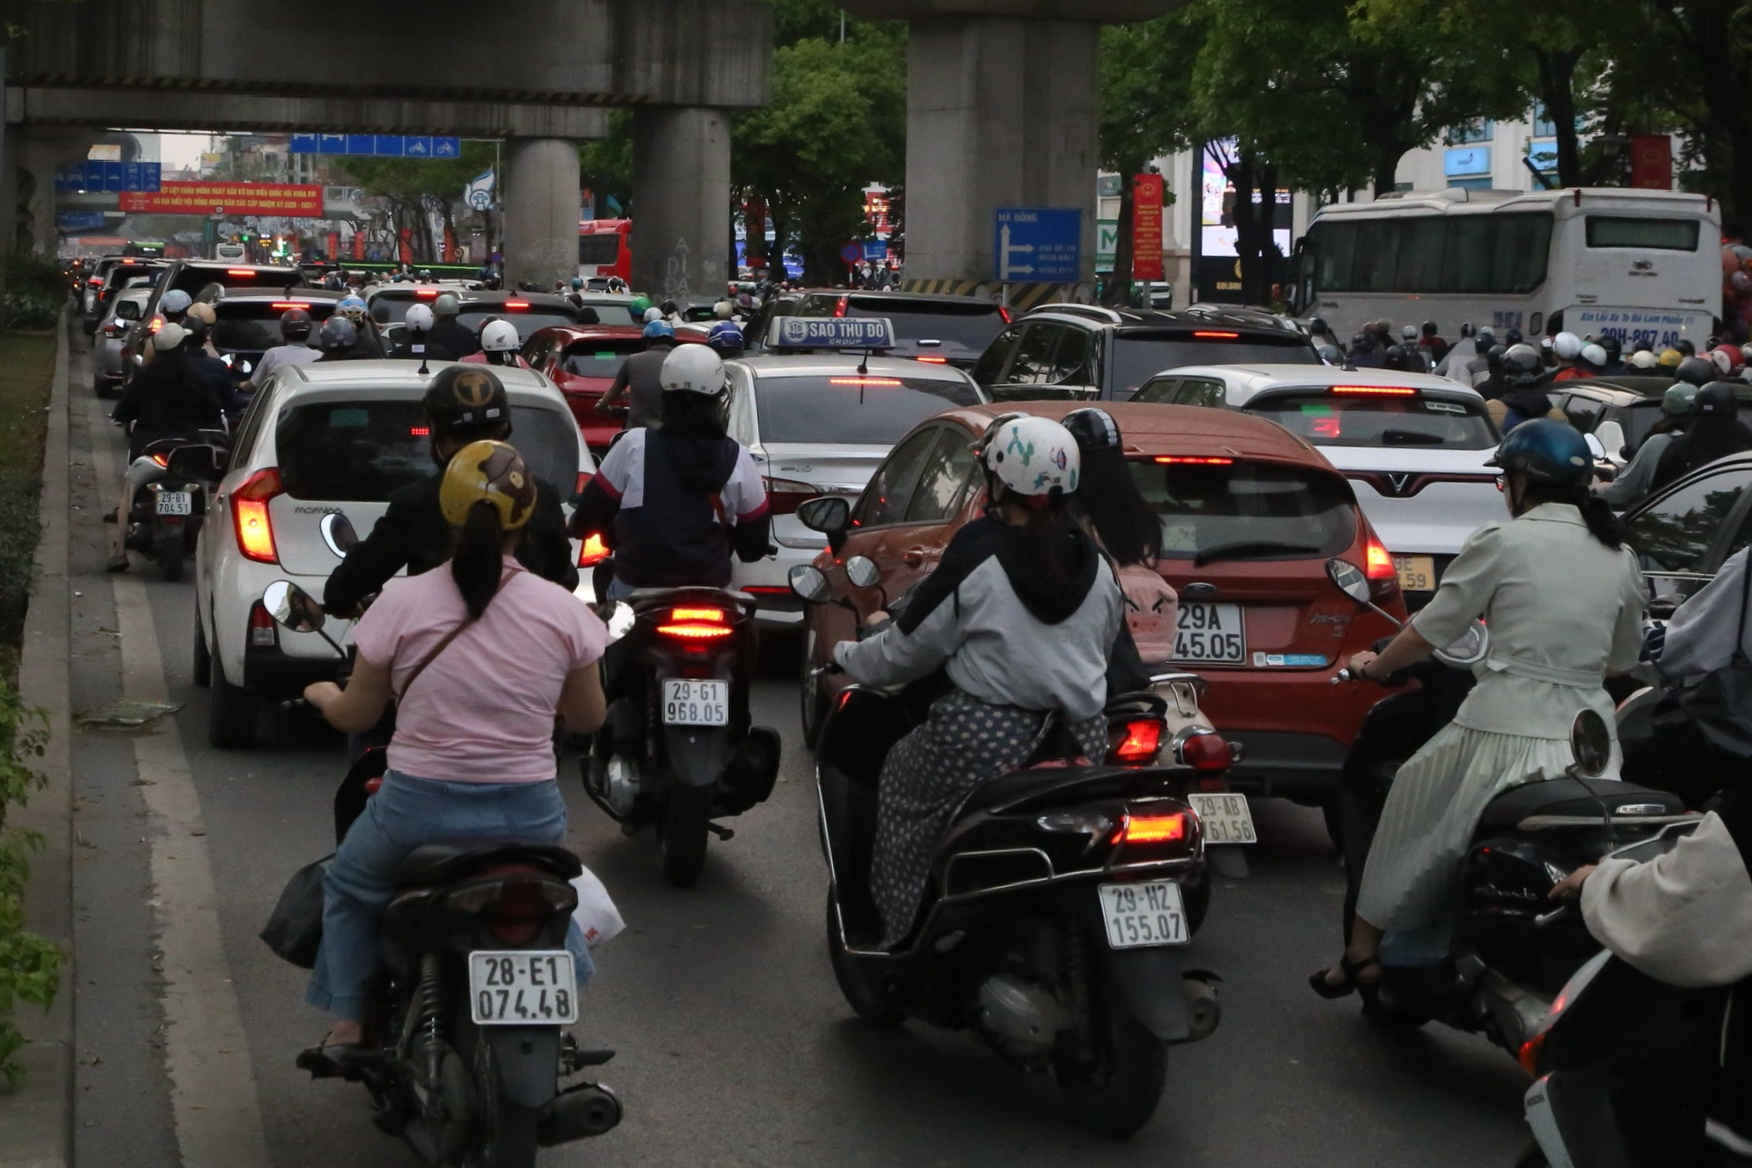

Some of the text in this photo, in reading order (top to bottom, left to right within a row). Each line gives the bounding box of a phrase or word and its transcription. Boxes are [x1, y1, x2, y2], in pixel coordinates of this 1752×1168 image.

[810, 323, 835, 337] SAO
[162, 493, 185, 503] 29-B1
[1177, 603, 1222, 630] 29A
[672, 682, 717, 701] 29-G1
[667, 702, 724, 722] 968.05
[1112, 885, 1171, 913] 29-H2
[1112, 913, 1180, 944] 155.07
[485, 957, 558, 986] 28-E1
[479, 989, 570, 1019] 074.48
